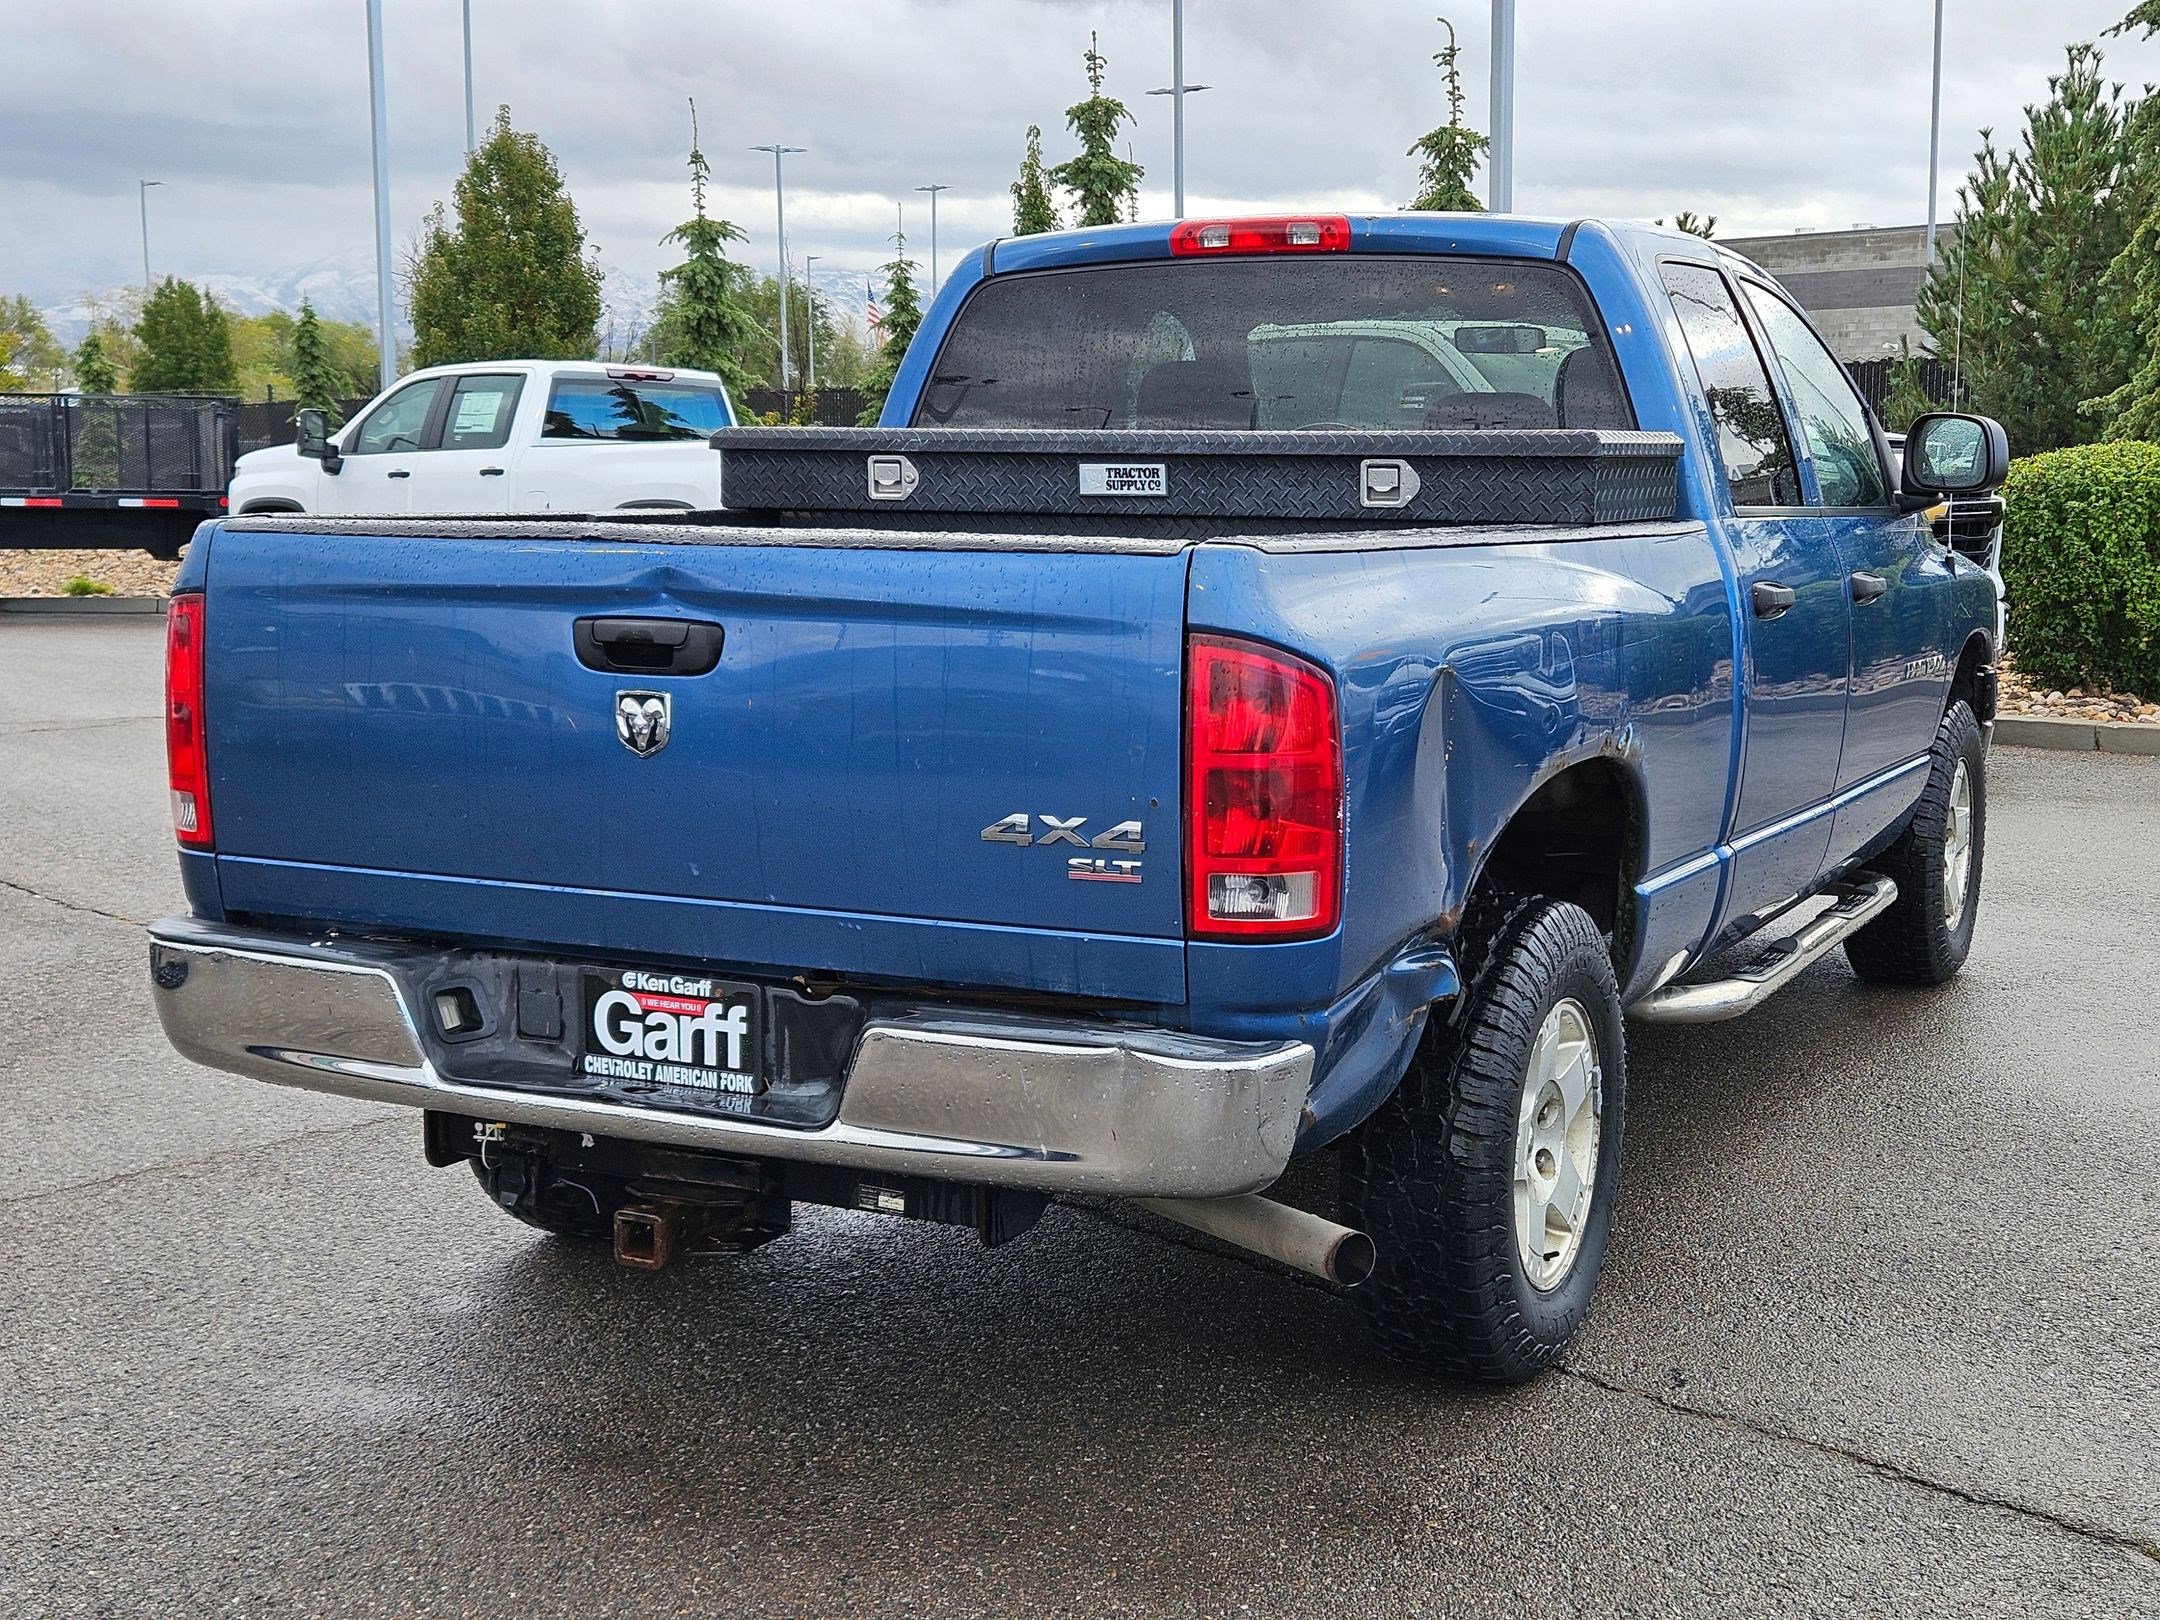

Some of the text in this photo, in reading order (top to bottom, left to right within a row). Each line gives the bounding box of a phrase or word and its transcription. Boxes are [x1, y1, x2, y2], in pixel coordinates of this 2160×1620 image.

[1105, 467, 1160, 479] TRACTOR
[1105, 479, 1147, 491] SUPPLY
[1067, 858, 1143, 876] SLT
[637, 973, 712, 998] Ken Garff
[647, 998, 697, 1011] WE HEAR YOU
[593, 989, 748, 1070] Garff
[584, 1054, 654, 1081] CHEVROLET
[655, 1064, 718, 1089] AMERICAN
[720, 1073, 754, 1095] FORK
